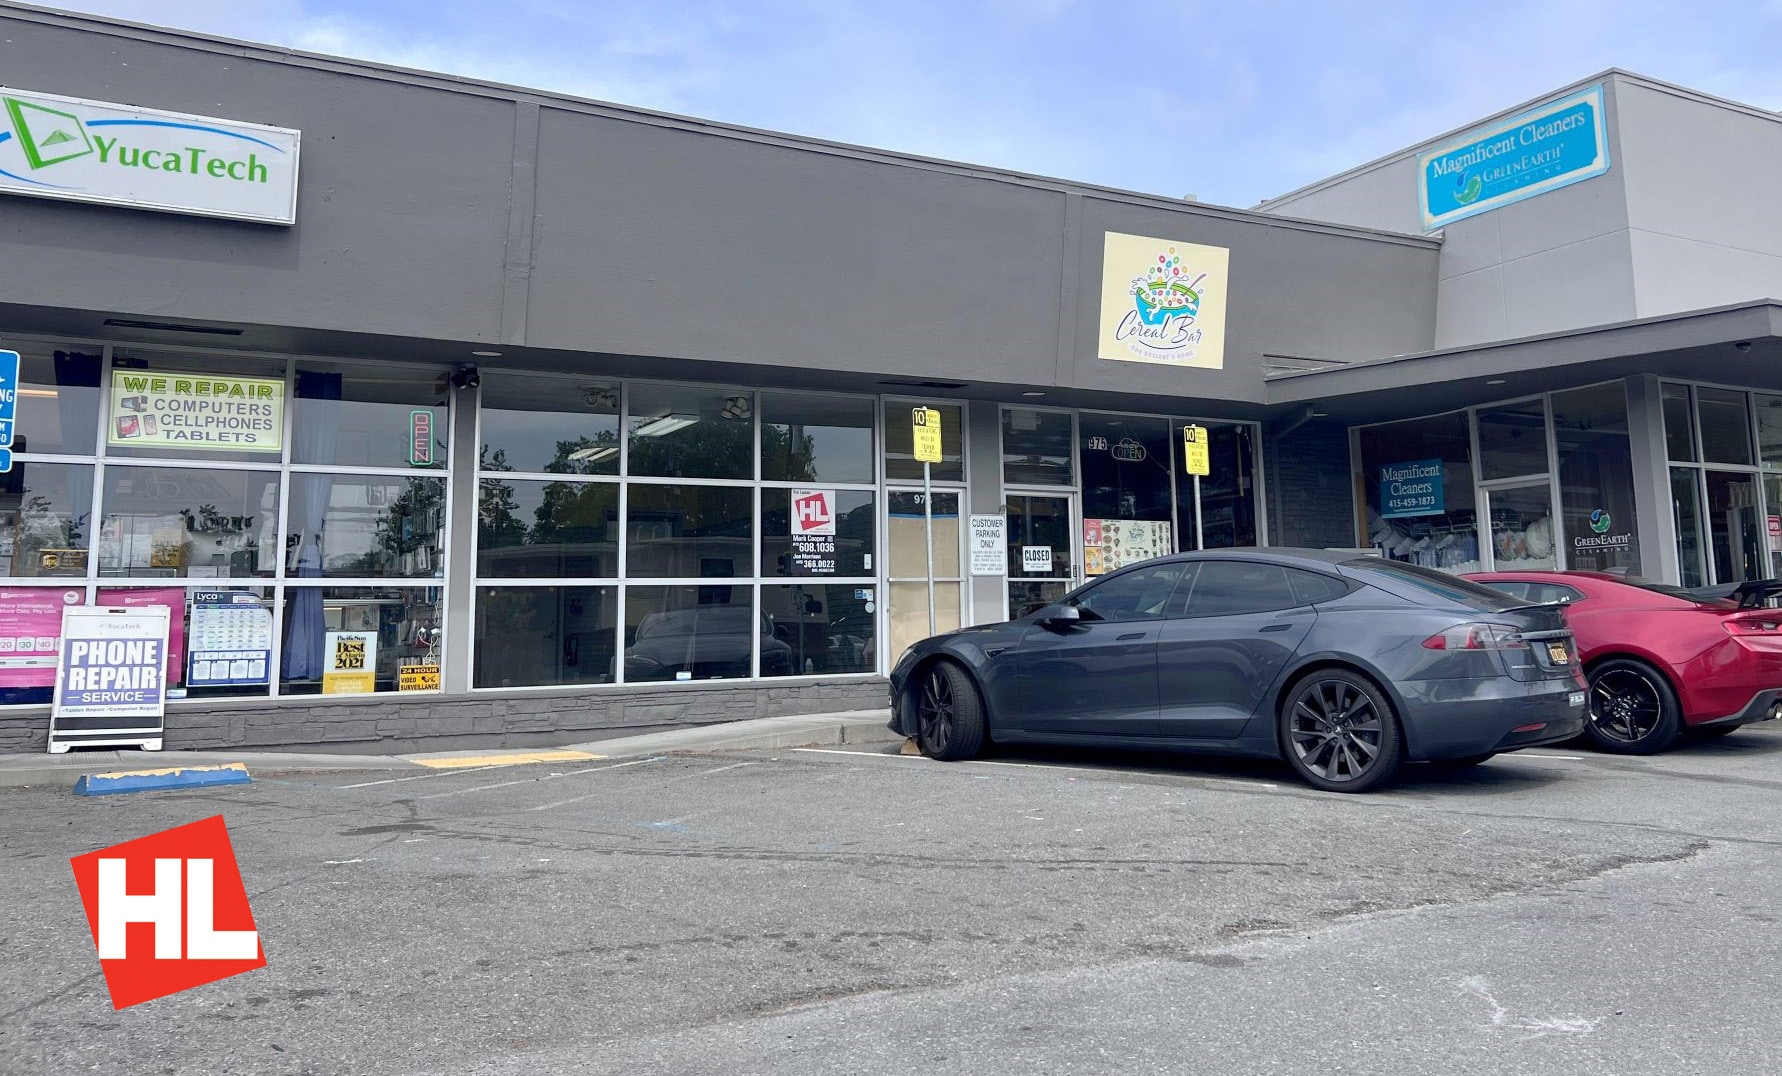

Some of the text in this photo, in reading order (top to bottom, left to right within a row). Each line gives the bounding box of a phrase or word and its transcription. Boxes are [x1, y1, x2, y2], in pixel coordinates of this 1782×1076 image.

[1433, 111, 1585, 178] Magnificent Cleaners
[92, 135, 268, 183] YucaTech
[1116, 309, 1202, 344] Cereal Bar
[123, 376, 273, 400] WE REPAIR
[154, 399, 272, 416] COMPUTERS
[160, 414, 273, 430] CELLPHONES
[914, 411, 925, 425] 10
[162, 429, 257, 443] TABLETS
[414, 414, 429, 462] OPEN
[1185, 429, 1195, 441] 10
[1089, 438, 1107, 449] 975
[1117, 449, 1142, 459] OPEN
[1383, 464, 1440, 482] Magnificent
[1390, 482, 1432, 496] Cleaners
[914, 495, 932, 504] 97
[1389, 496, 1435, 507] 415-459-1873
[799, 500, 829, 521] HL
[972, 519, 1003, 528] CUSTOMER
[976, 529, 1001, 538] PARKING
[799, 543, 834, 552] 608.1036
[980, 540, 994, 548] ONLY
[1024, 549, 1050, 561] CLOSED
[197, 593, 218, 601] Lyca
[70, 641, 157, 666] PHONE
[337, 642, 365, 653] Best
[335, 658, 364, 669] 2021
[68, 667, 157, 691] REPAIR
[82, 691, 144, 702] SERVICE
